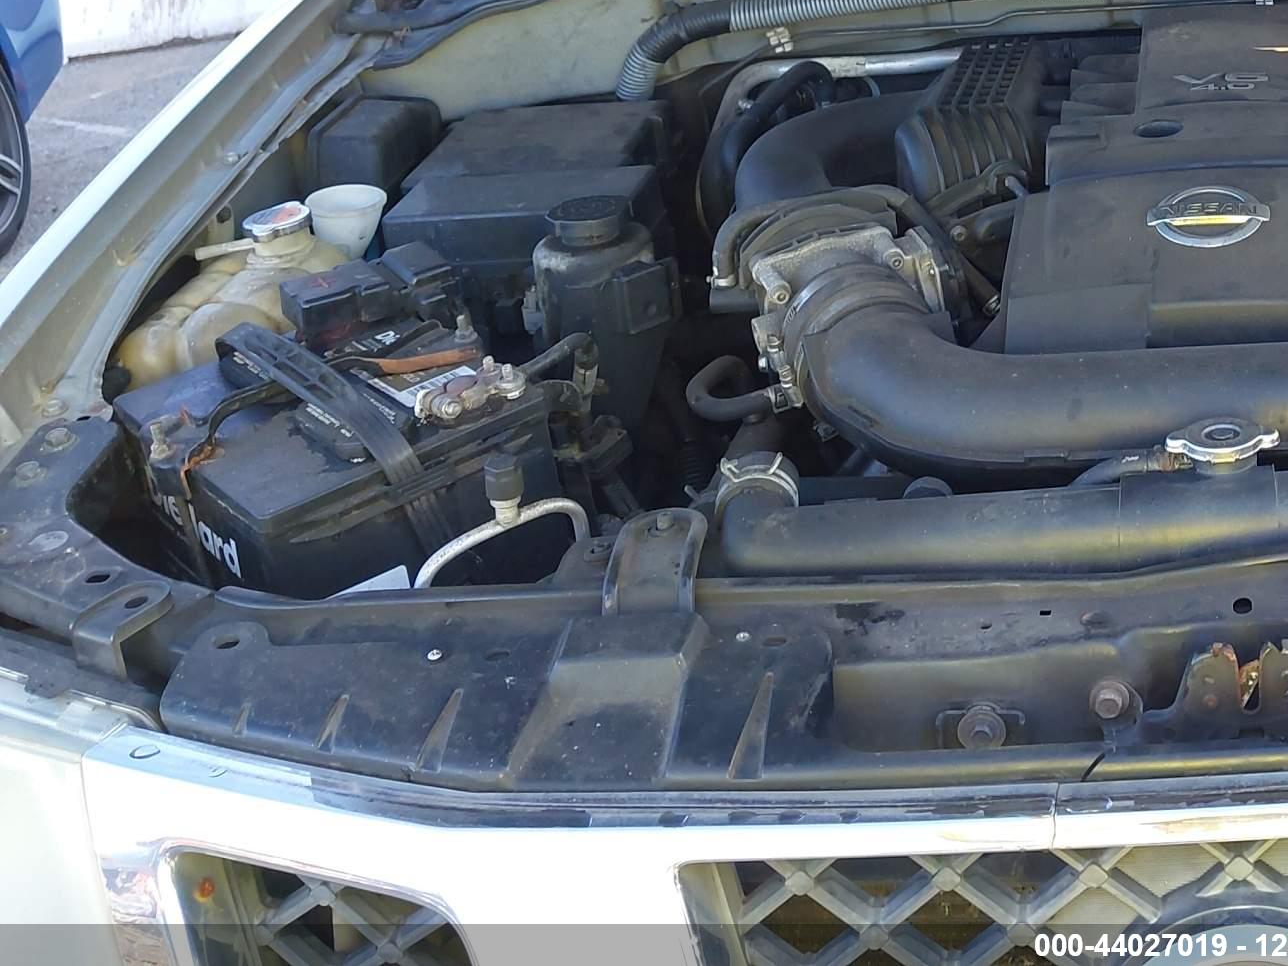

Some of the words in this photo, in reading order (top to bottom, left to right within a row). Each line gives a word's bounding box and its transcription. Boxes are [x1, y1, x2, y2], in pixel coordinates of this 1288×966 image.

[1173, 71, 1269, 84] V6
[1190, 82, 1255, 91] 4.0
[1159, 201, 1258, 216] NISSAN
